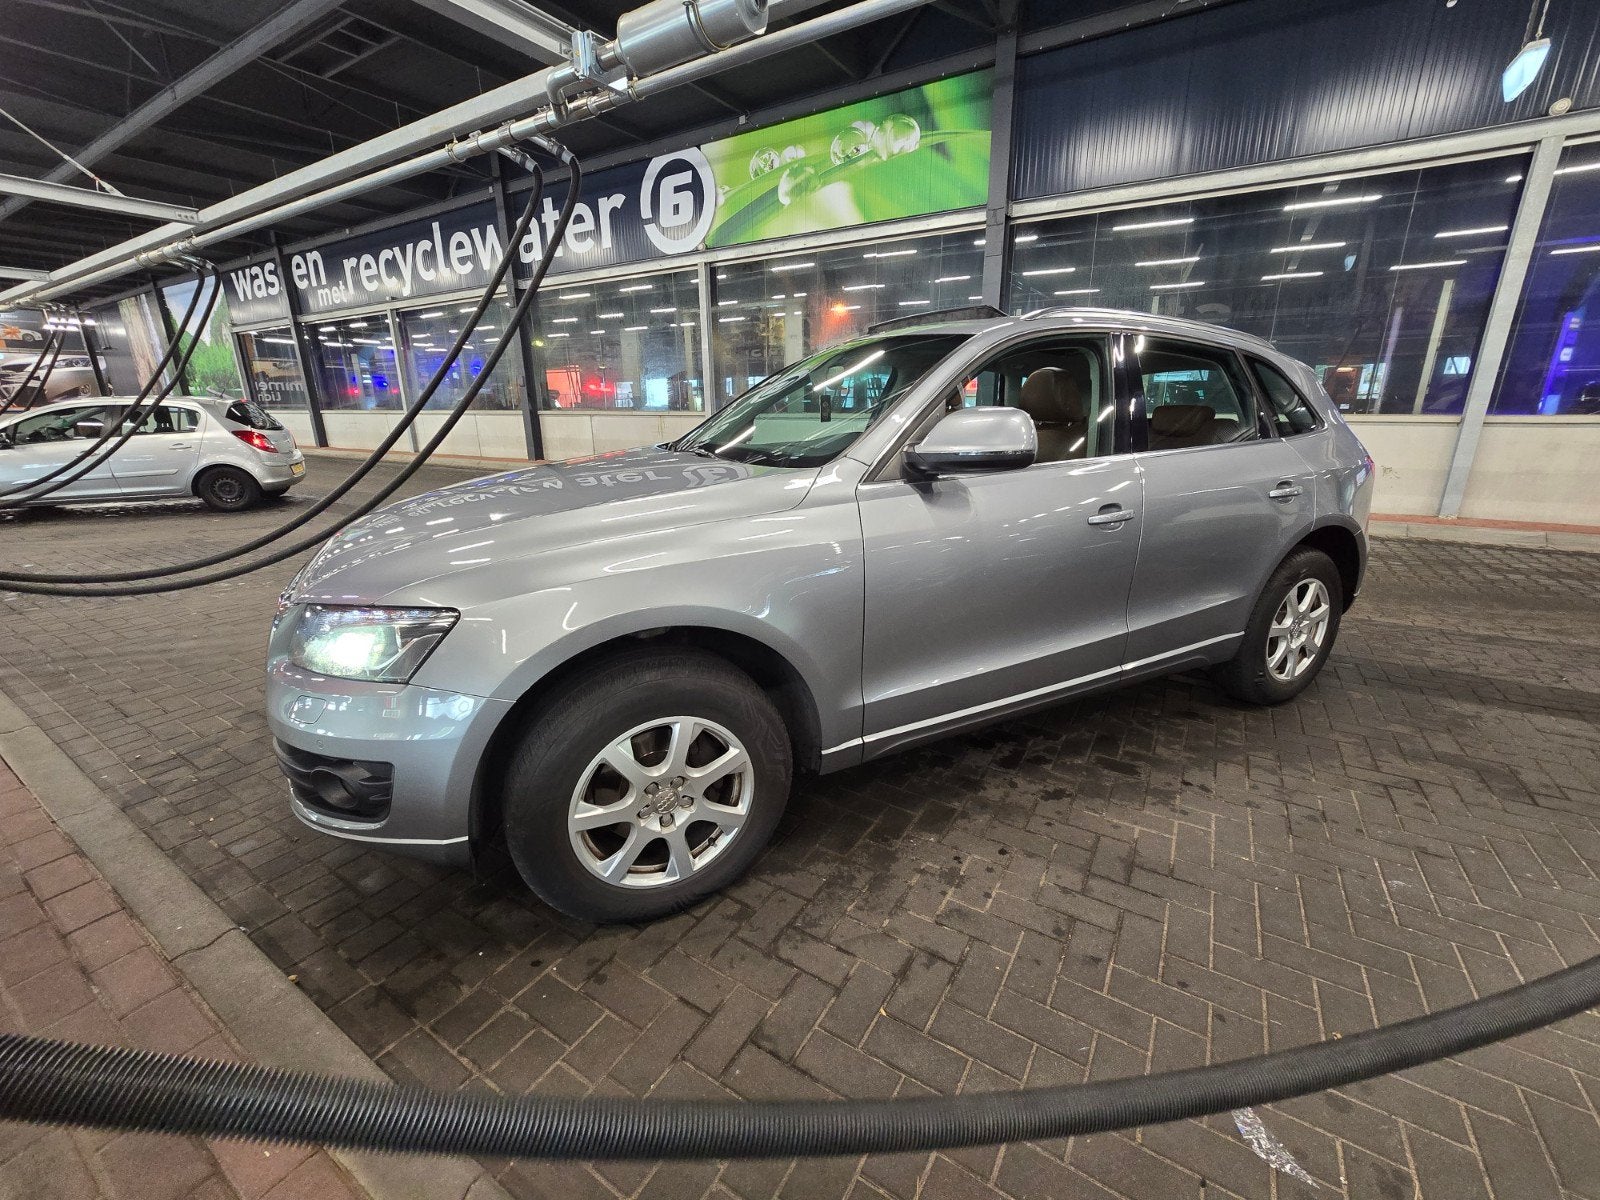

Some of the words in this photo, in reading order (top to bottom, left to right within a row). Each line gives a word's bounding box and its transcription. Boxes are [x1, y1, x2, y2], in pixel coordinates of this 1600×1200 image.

[342, 192, 627, 297] recyclewater
[230, 250, 327, 302] wasen
[317, 281, 348, 307] met
